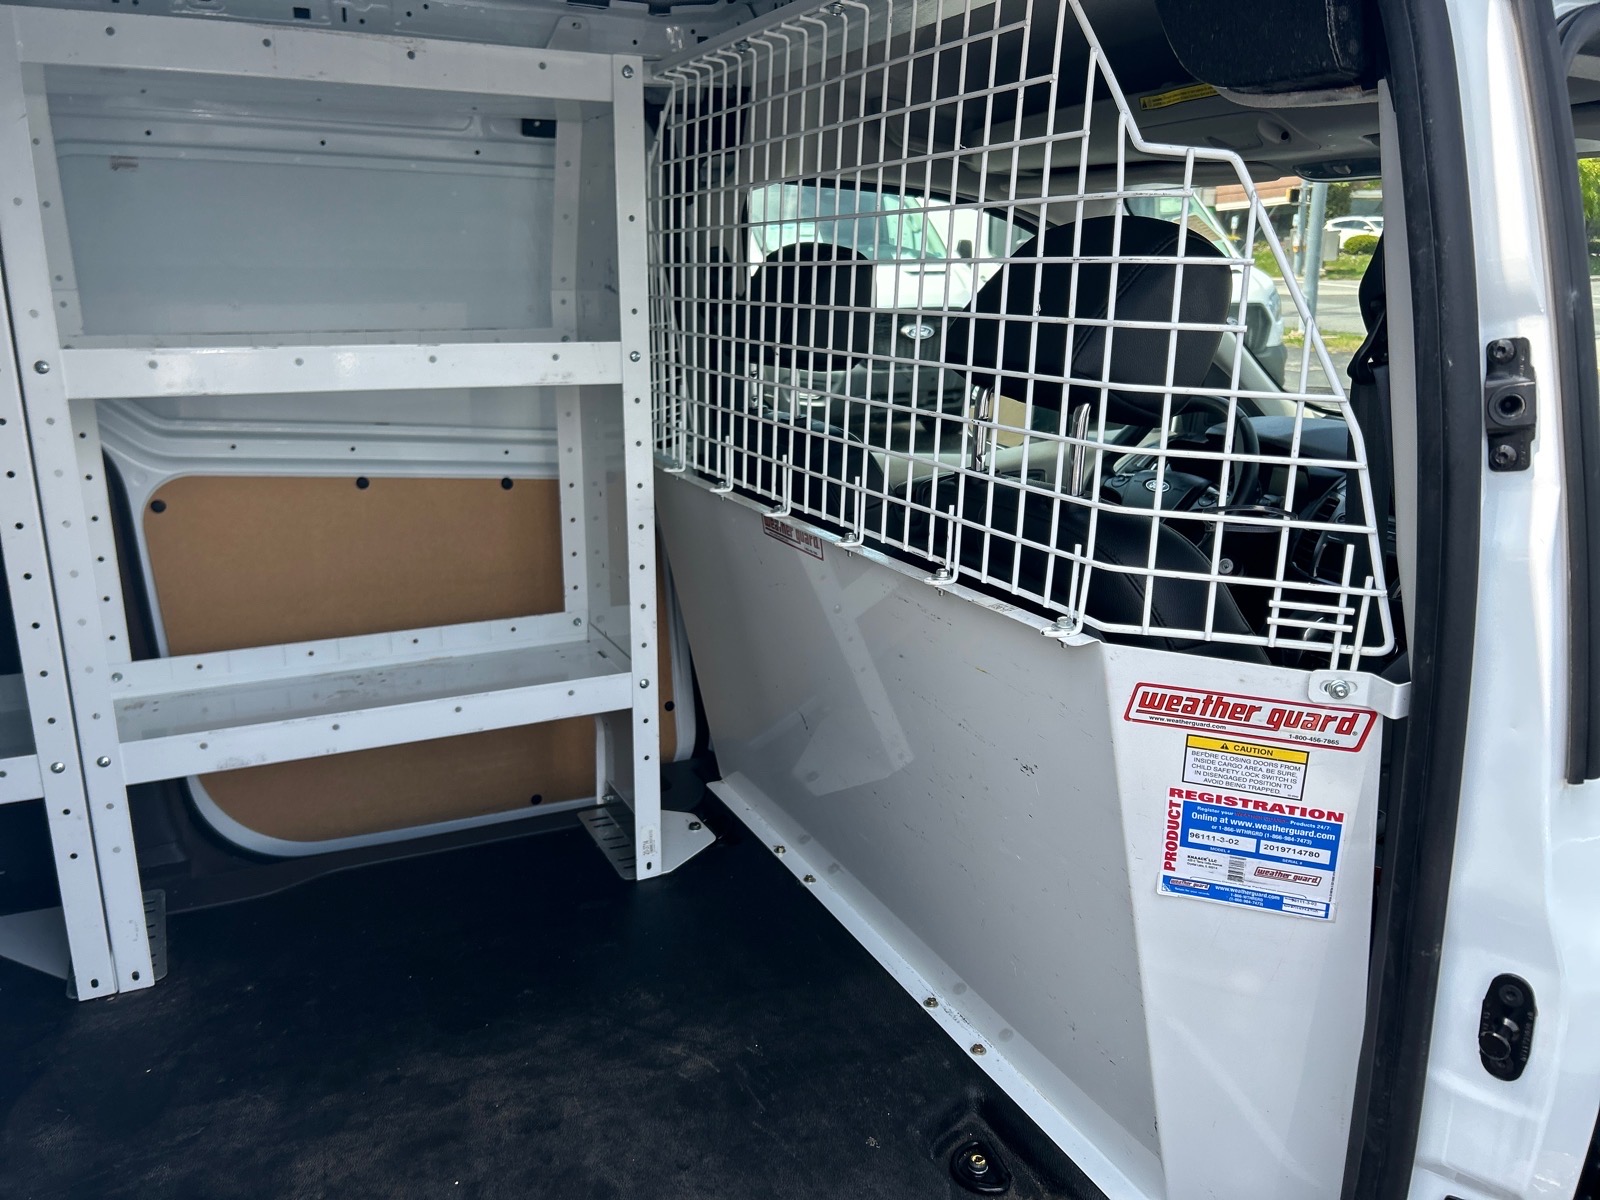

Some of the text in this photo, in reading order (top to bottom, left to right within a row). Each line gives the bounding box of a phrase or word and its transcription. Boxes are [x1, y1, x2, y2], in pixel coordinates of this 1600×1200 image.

[1138, 691, 1360, 736] weather guard
[1149, 715, 1226, 730] www.weatherguard.com
[1289, 734, 1340, 746] 1-800-456-7865
[1234, 744, 1274, 757] CAUTION
[1191, 750, 1301, 772] BEFORE CLOSING DOORS FROM
[1193, 757, 1217, 766] INSIDE
[1217, 761, 1243, 770] CARGO
[1191, 763, 1212, 771] CHILD
[1213, 766, 1240, 775] SAFETY
[1241, 770, 1260, 778] LOCK
[1261, 773, 1289, 783] SWITCH
[1202, 771, 1247, 783] DISENGAGED
[1248, 777, 1281, 789] POSITION
[1203, 778, 1224, 786] AVOID
[1225, 781, 1246, 789] BEING
[1169, 788, 1345, 823] REGISTRATION
[1197, 806, 1220, 815] Register
[1221, 809, 1234, 817] your
[1290, 820, 1316, 829] Products
[1191, 811, 1336, 841] Online at www.weatherguard.com
[1163, 799, 1182, 872] PRODUCT
[1189, 832, 1240, 846] 96111-3-02
[1210, 846, 1227, 854] MODEL
[1263, 844, 1320, 859] 2019714780
[1257, 868, 1319, 884] weather guard
[1215, 885, 1280, 901] www.weatherguard.com
